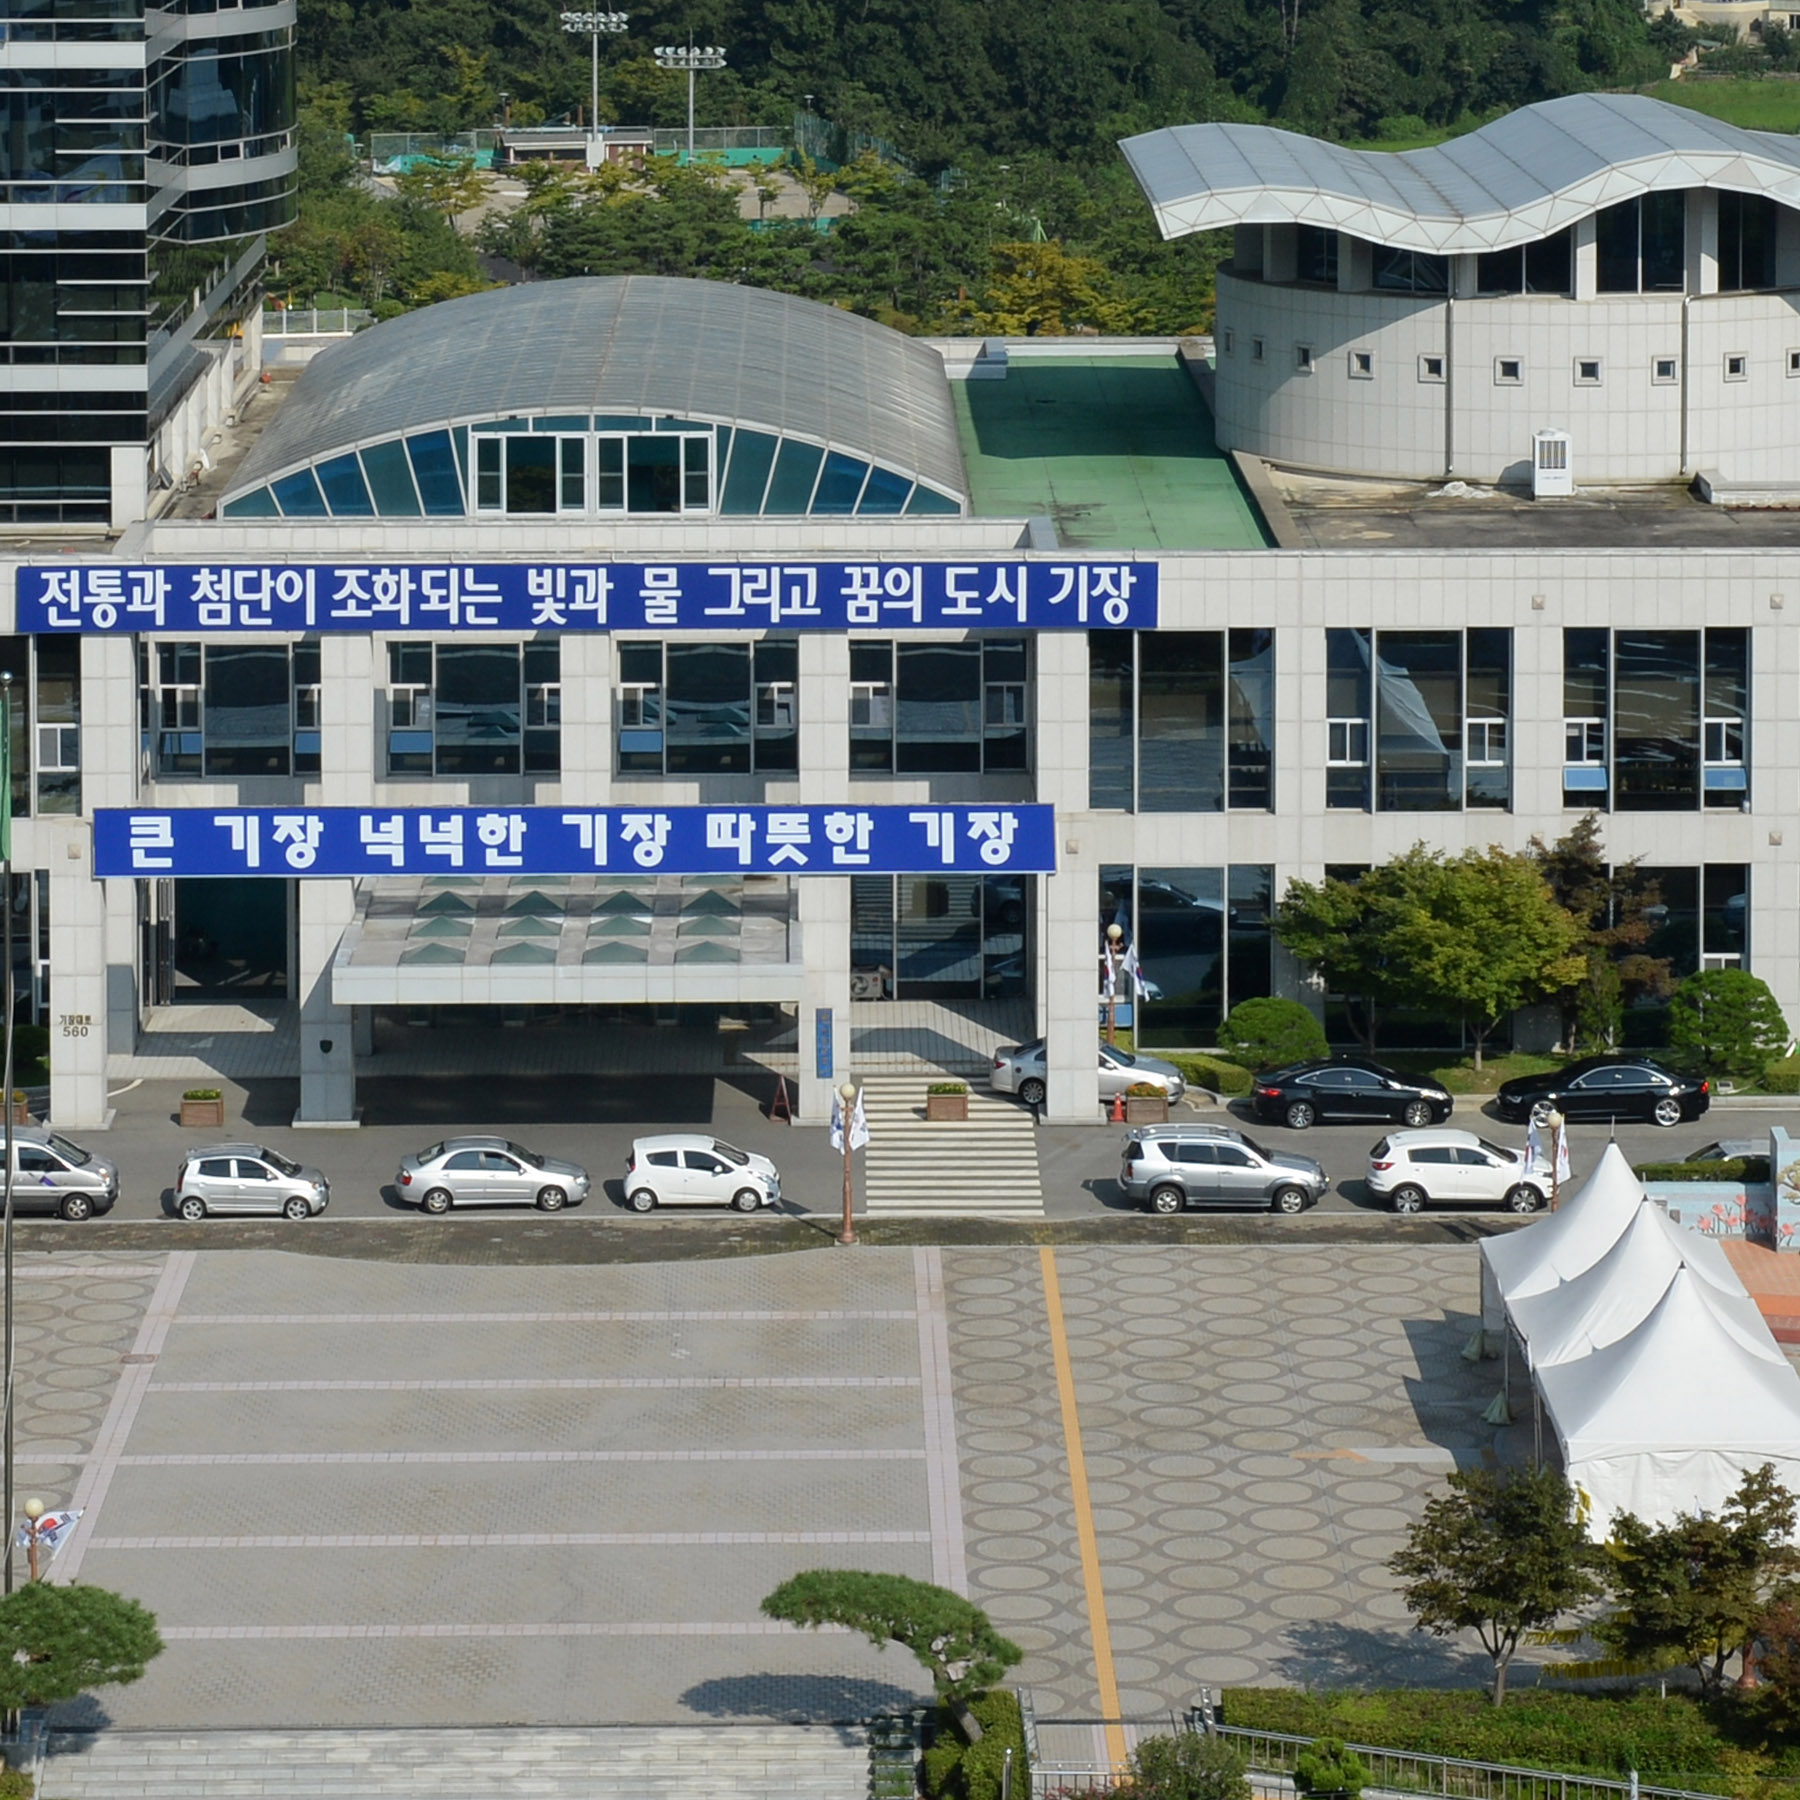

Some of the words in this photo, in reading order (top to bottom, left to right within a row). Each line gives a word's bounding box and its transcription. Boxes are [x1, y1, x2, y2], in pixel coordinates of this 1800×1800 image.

[38, 569, 172, 628] 전통과
[190, 568, 316, 626] 첨단이
[330, 568, 503, 625] 조화되는
[527, 567, 614, 624] 빛과
[639, 567, 682, 624] 물
[704, 566, 821, 623] 그리고
[840, 566, 922, 623] 꿈의
[941, 566, 1027, 622] 도시
[1048, 565, 1137, 624] 기장
[129, 816, 174, 868] 큰
[214, 815, 324, 868] 기장
[360, 814, 527, 867] 넉넉한
[562, 813, 672, 867] 기장
[706, 812, 874, 865] 따뜻한
[909, 812, 1019, 865] 기장
[63, 1025, 89, 1038] 560
